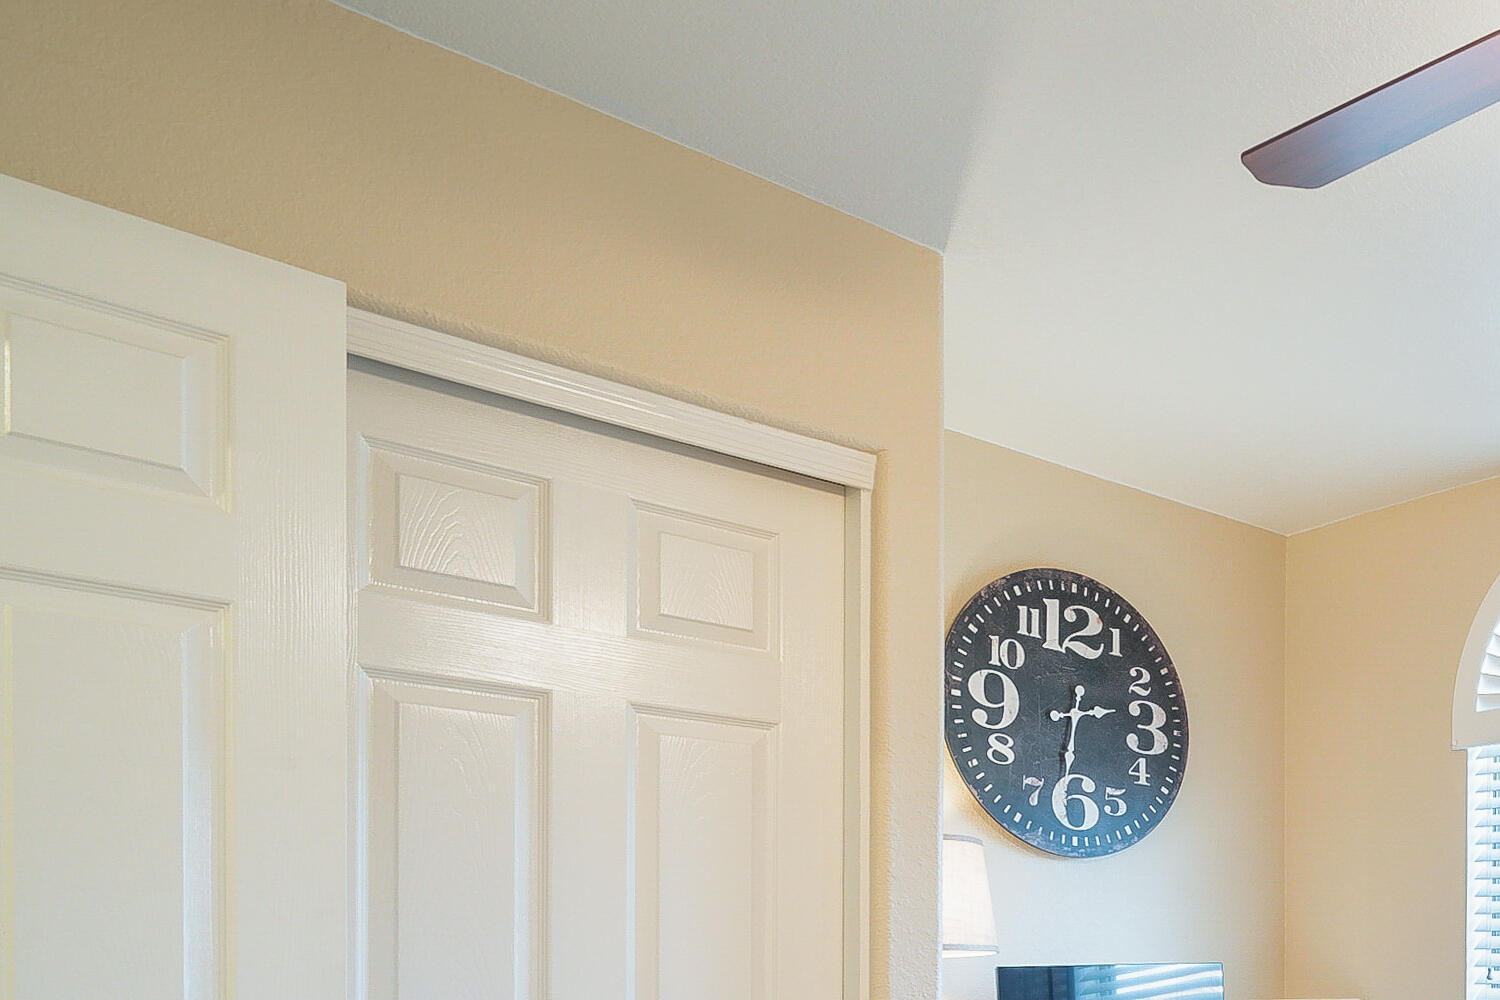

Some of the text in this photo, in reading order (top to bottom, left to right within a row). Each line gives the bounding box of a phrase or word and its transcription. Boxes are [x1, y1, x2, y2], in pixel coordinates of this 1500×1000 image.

[1017, 605, 1042, 639] 11
[1041, 598, 1105, 660] 12
[988, 635, 1025, 670] 10
[1108, 627, 1123, 657] 1
[1129, 666, 1152, 696] 2
[968, 669, 1020, 730] 9
[1126, 700, 1169, 755] 3
[986, 733, 1016, 765] 8
[1128, 757, 1151, 786] 4
[1022, 775, 1044, 806] 7
[1051, 773, 1100, 831] 6
[1104, 787, 1128, 816] 5
